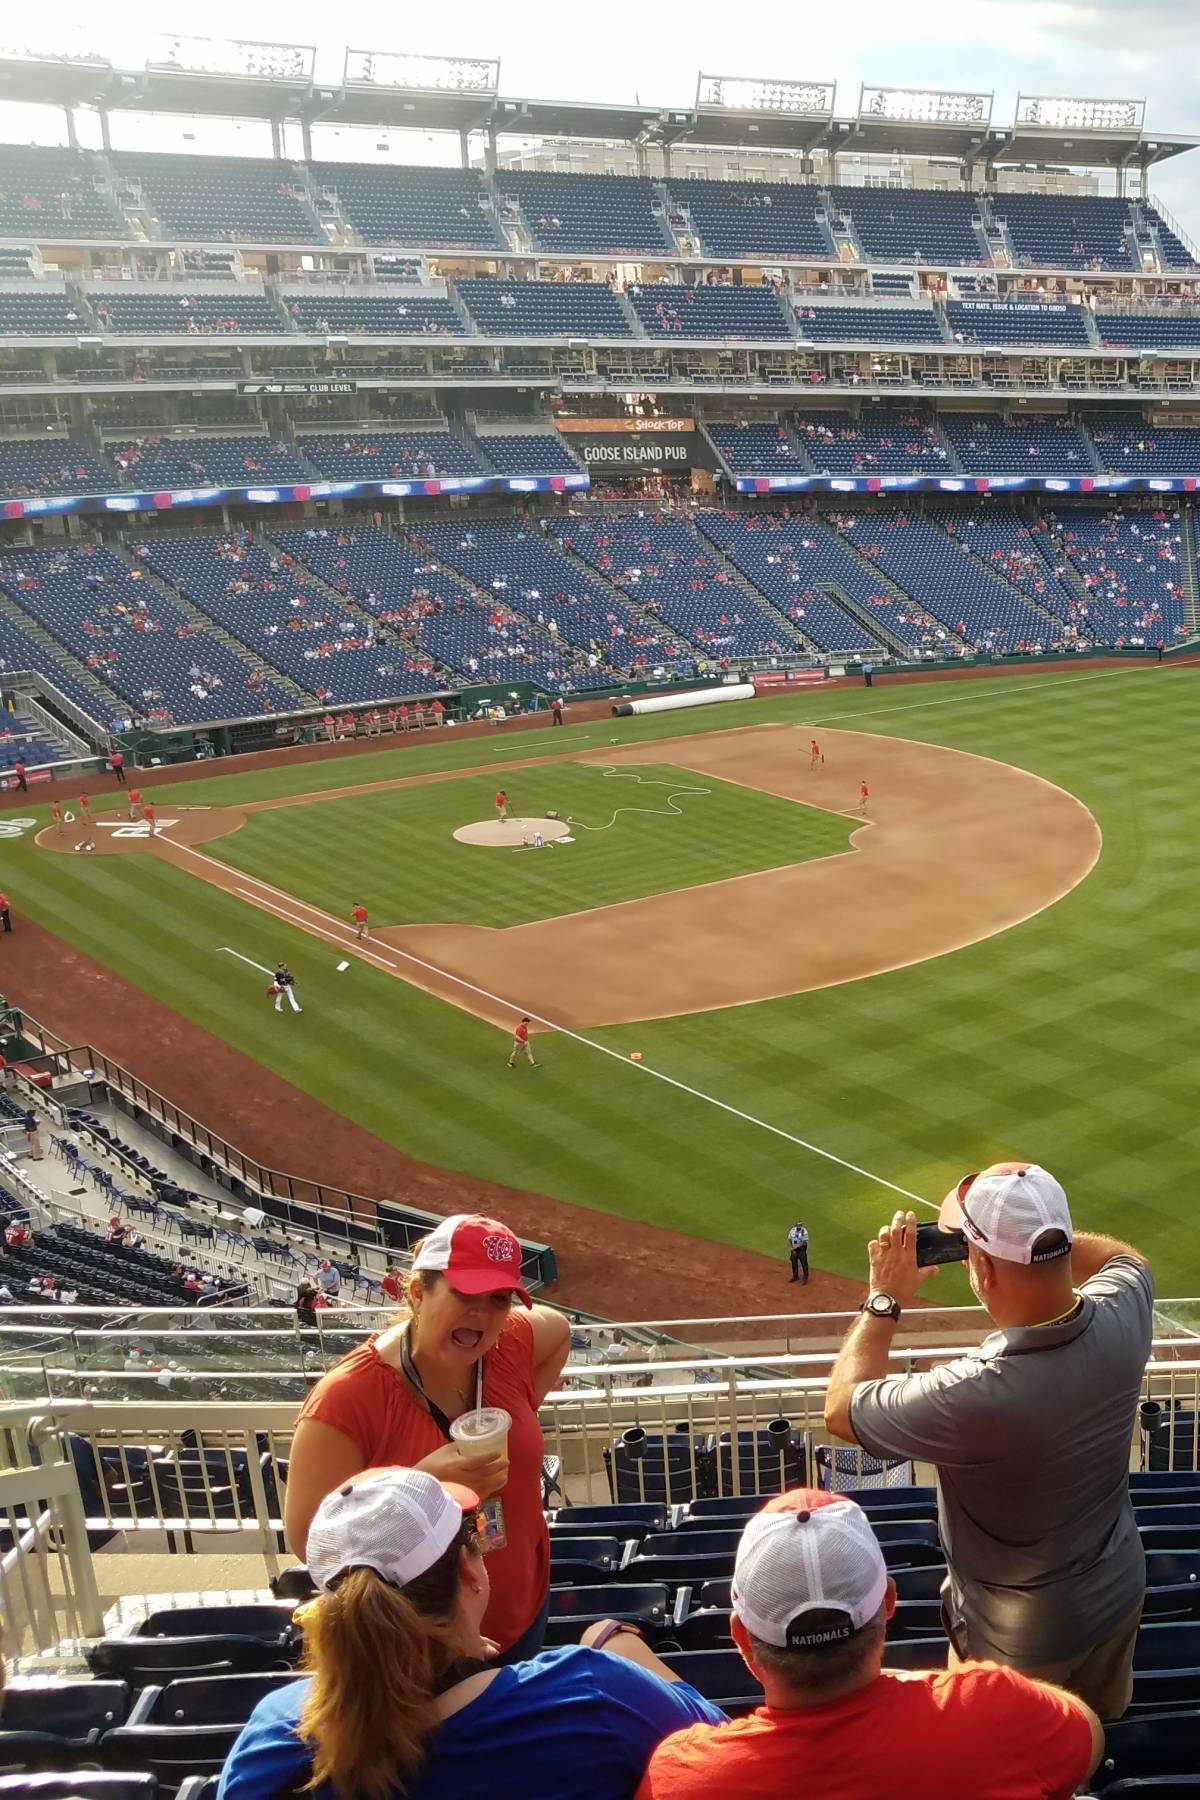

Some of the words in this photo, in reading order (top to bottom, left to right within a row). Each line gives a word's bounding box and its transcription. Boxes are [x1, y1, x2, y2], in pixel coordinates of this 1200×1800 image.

[309, 384, 329, 392] CLUB
[330, 384, 352, 392] LEVEL
[584, 446, 621, 461] GOOSE
[623, 446, 663, 461] ISLAND
[664, 446, 688, 460] PUB
[1032, 1245, 1070, 1263] NATIONALS
[791, 1627, 850, 1645] NATIONALS
